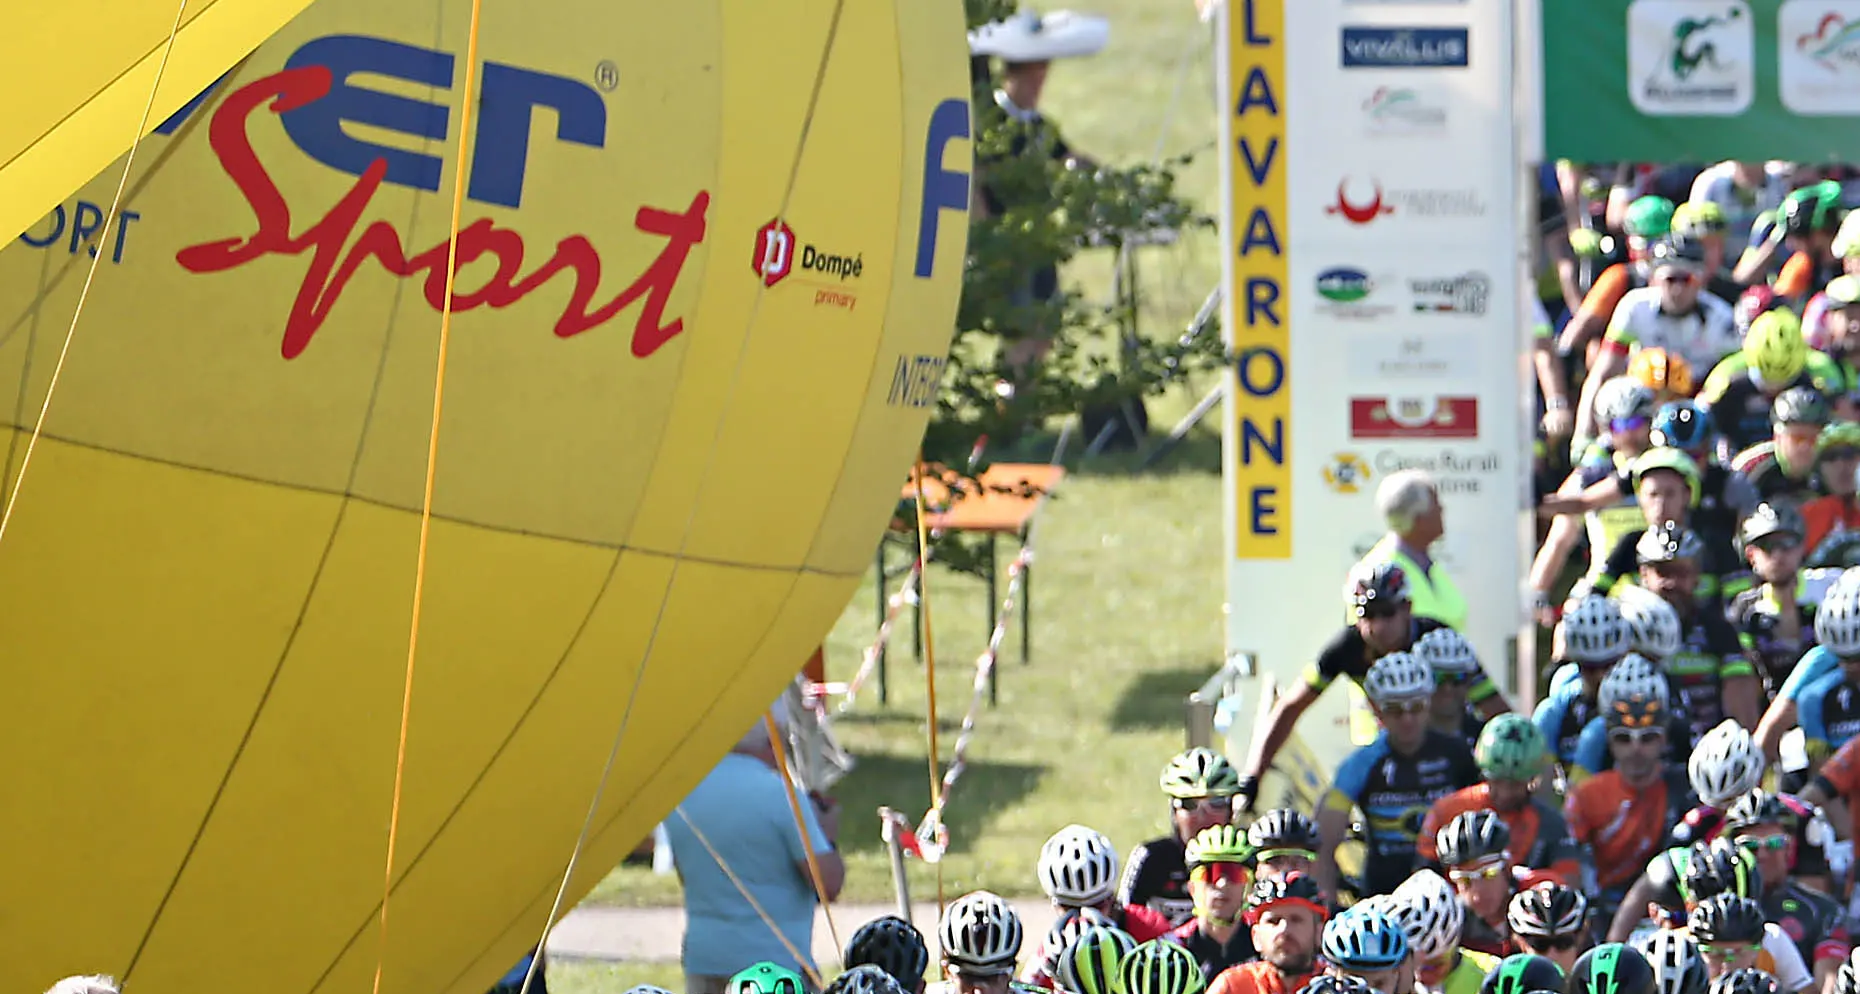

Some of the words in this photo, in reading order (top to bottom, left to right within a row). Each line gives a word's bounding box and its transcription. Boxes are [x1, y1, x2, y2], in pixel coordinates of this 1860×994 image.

[176, 64, 711, 360] Sport
[802, 244, 864, 281] Dompé
[1236, 0, 1285, 534] LAVARONE
